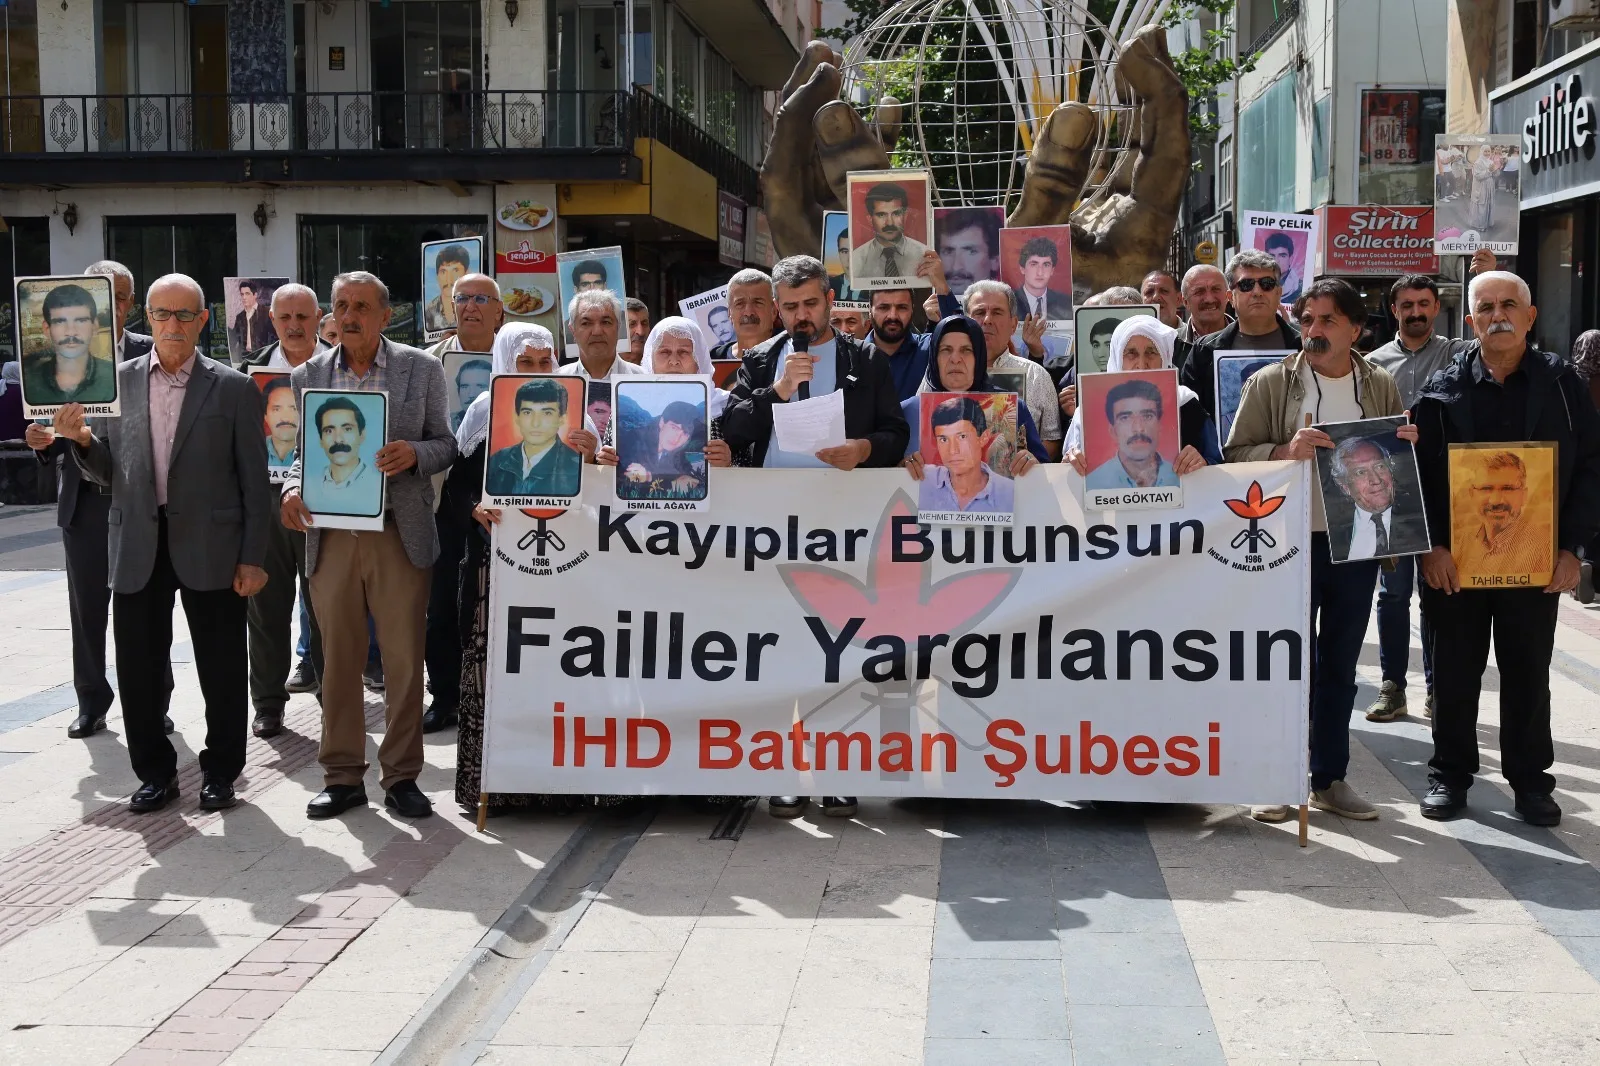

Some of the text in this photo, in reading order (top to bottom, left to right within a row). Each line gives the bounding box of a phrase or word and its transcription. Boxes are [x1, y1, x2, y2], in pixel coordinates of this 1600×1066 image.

[1522, 74, 1592, 163] stilife
[1250, 216, 1312, 230] EDİP ÇELİK
[1348, 210, 1418, 236] Şirin
[1334, 234, 1432, 249] Collection
[1442, 243, 1482, 251] MERYEM
[686, 290, 728, 311] İBRAHİM Ç
[30, 406, 114, 416] MAHM MİREL
[493, 497, 533, 507] M.ŞİRİN
[1095, 492, 1173, 505] Eset GÖKTAYI
[627, 502, 696, 510] İSMAİL AĞAYA
[919, 513, 1012, 522] MEHMET ZEKİ AKYILDIZ
[598, 505, 1205, 572] Kayıplar Bulunsun
[495, 546, 590, 576] İNSAN HAKLARI DERNEĞİ
[532, 558, 550, 567] 1986
[1207, 546, 1300, 572] İNSAN HAKLARI DERNEĞİ
[1245, 555, 1262, 564] 1986
[1471, 574, 1530, 586] TAHİR ELÇİ
[506, 606, 1302, 699] Failler Yargılansın
[552, 702, 1221, 788] İHD Batman Şubesi
